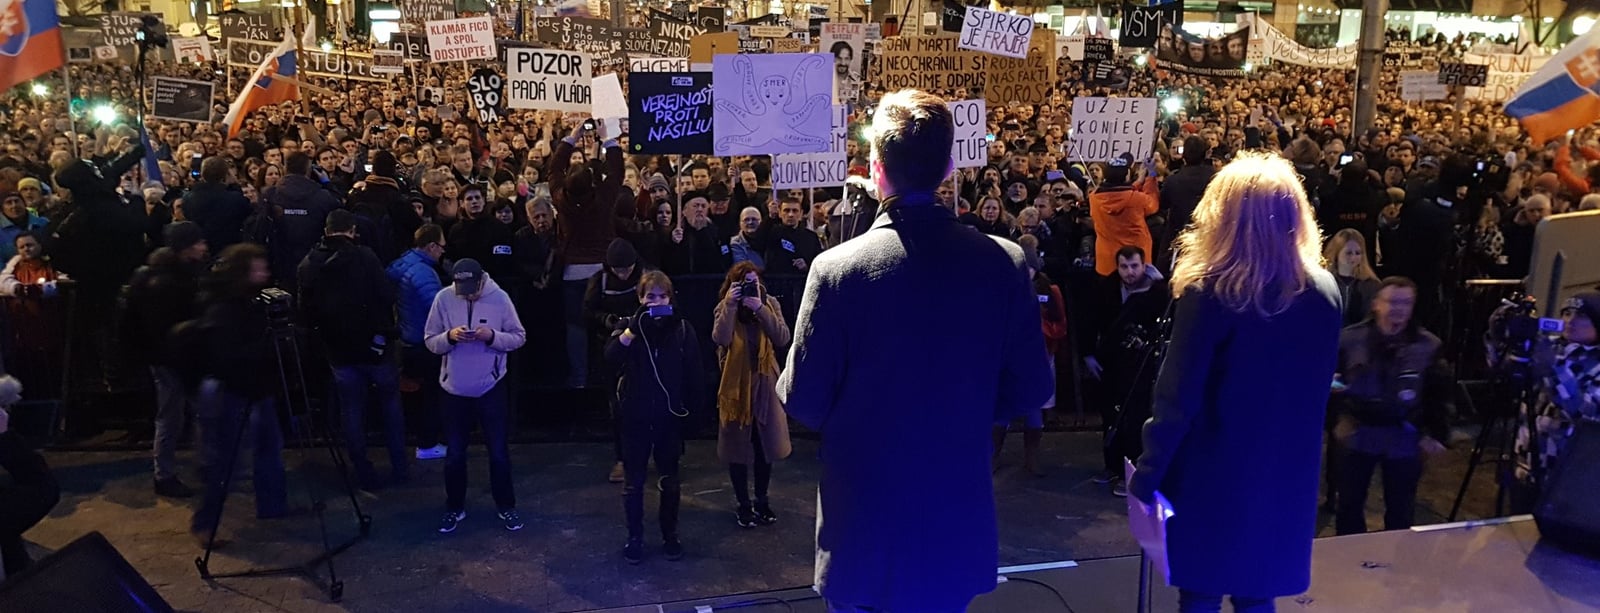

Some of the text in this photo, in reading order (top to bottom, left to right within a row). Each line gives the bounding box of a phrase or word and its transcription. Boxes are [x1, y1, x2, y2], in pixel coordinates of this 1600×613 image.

[430, 20, 489, 36] KLAMÁR FICO
[825, 24, 860, 34] NETFLIX
[445, 38, 451, 46] A
[778, 40, 799, 50] PRESS
[918, 38, 970, 52] MARTI
[962, 28, 1027, 55] JE FRAJER
[517, 51, 582, 77] POZOR
[886, 54, 963, 71] NEOCHRÁNILI
[1439, 61, 1486, 74] MAFIA
[512, 77, 592, 104] PADÁ VLÁDA
[655, 106, 699, 124] PROTI
[1116, 100, 1140, 114] JE
[1077, 117, 1144, 135] KONIEC
[956, 131, 987, 161] TÚP
